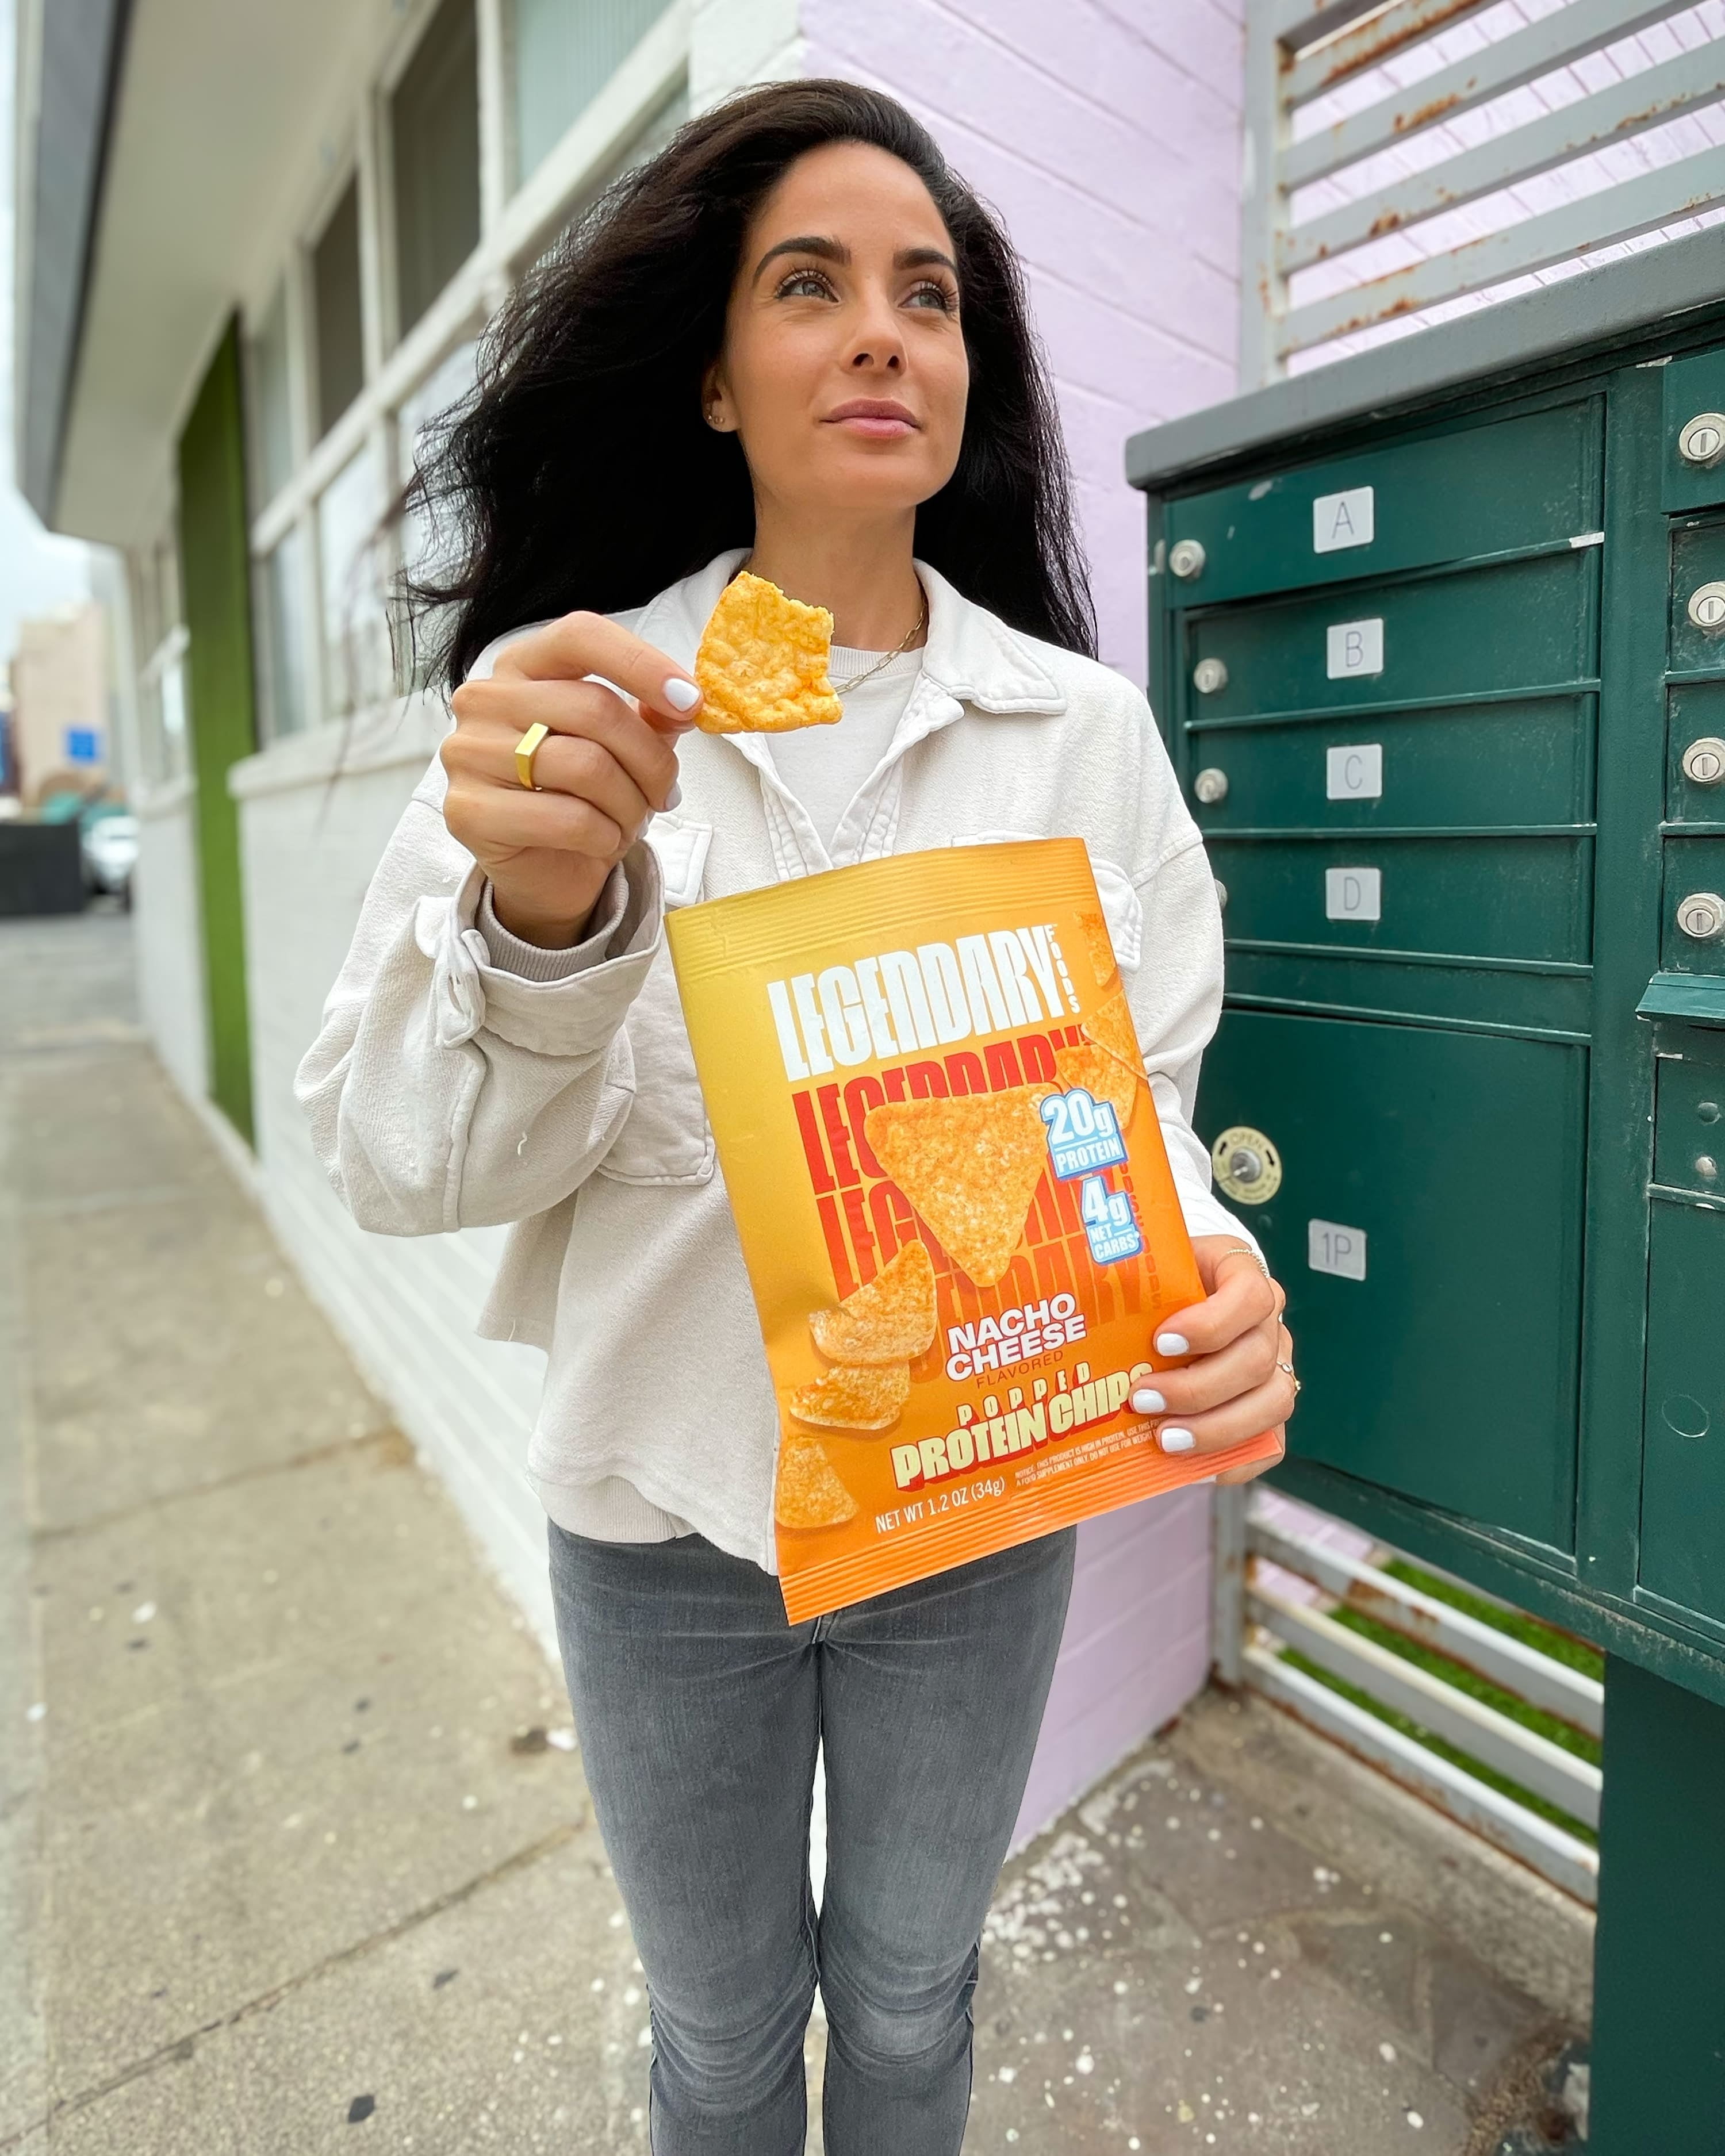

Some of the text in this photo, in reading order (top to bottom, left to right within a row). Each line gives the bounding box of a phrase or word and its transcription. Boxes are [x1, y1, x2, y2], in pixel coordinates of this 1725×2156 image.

[1331, 501, 1355, 540] A
[1346, 630, 1363, 667] B
[1344, 754, 1363, 791] C
[1343, 876, 1362, 911] D
[1044, 924, 1081, 1014] FOODS
[766, 926, 1065, 1082] LEGENDARY
[1044, 1092, 1115, 1145] 20g
[1056, 1137, 1121, 1173] PROTEIN
[1084, 1179, 1131, 1226] 4g
[1090, 1223, 1113, 1244] NET
[1322, 1232, 1352, 1265] 1P
[948, 1293, 1076, 1354] NACHO
[946, 1314, 1087, 1381] CHEESE
[976, 1351, 1064, 1390] FLAVORED
[957, 1361, 1091, 1428] POPPED
[890, 1401, 1048, 1489] PROTEIN
[875, 1475, 1006, 1534] NET WT 1.2 OZ (34g)
